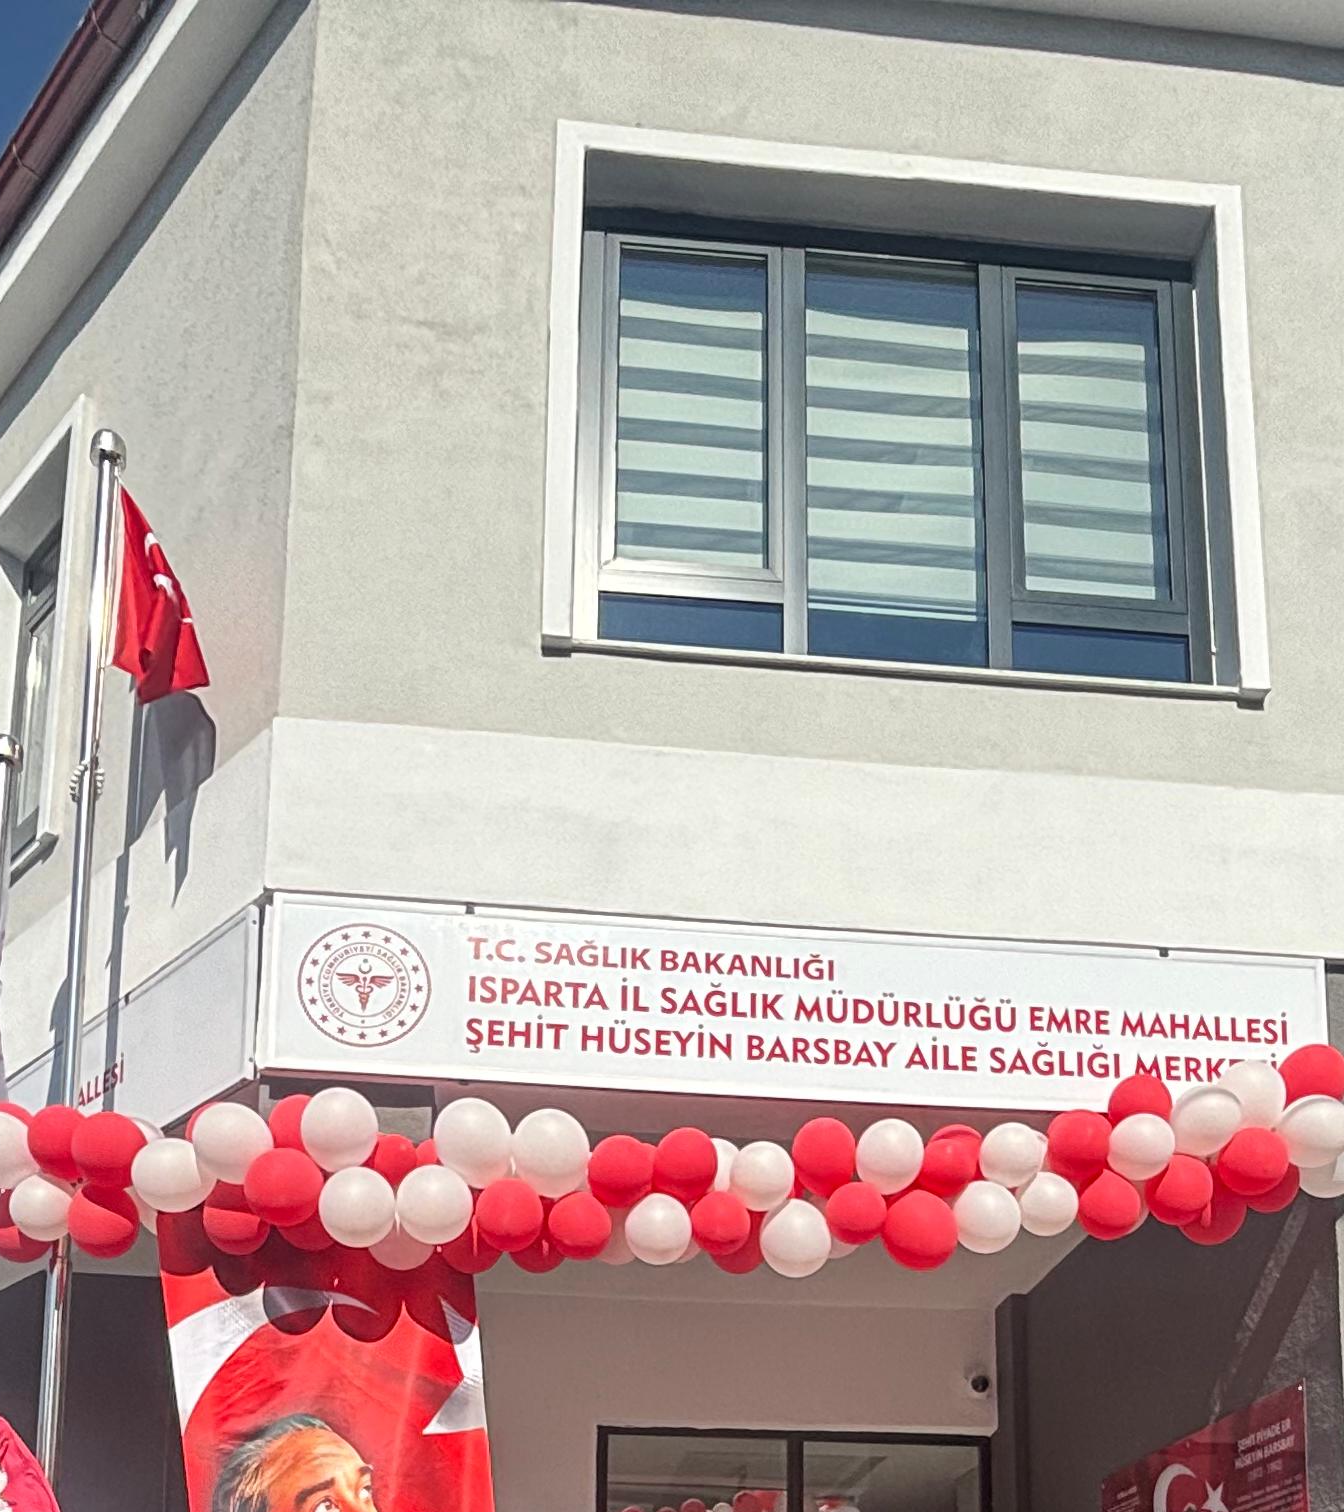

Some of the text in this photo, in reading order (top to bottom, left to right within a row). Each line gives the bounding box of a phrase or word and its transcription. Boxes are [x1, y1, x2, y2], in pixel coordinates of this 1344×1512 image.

[467, 936, 836, 981] T.C. SAĞLIK BAKANLIĞI
[468, 975, 1289, 1045] ISPARTA İL SAĞLIK MÜDÜRLÜĞÜ EMRE MAHALLESİ
[78, 1051, 125, 1106] ALLESİ
[465, 1014, 1277, 1083] ŞEHİT HÜSEYİN BARSBAY AİLE SAĞLIĞI MERKİ
